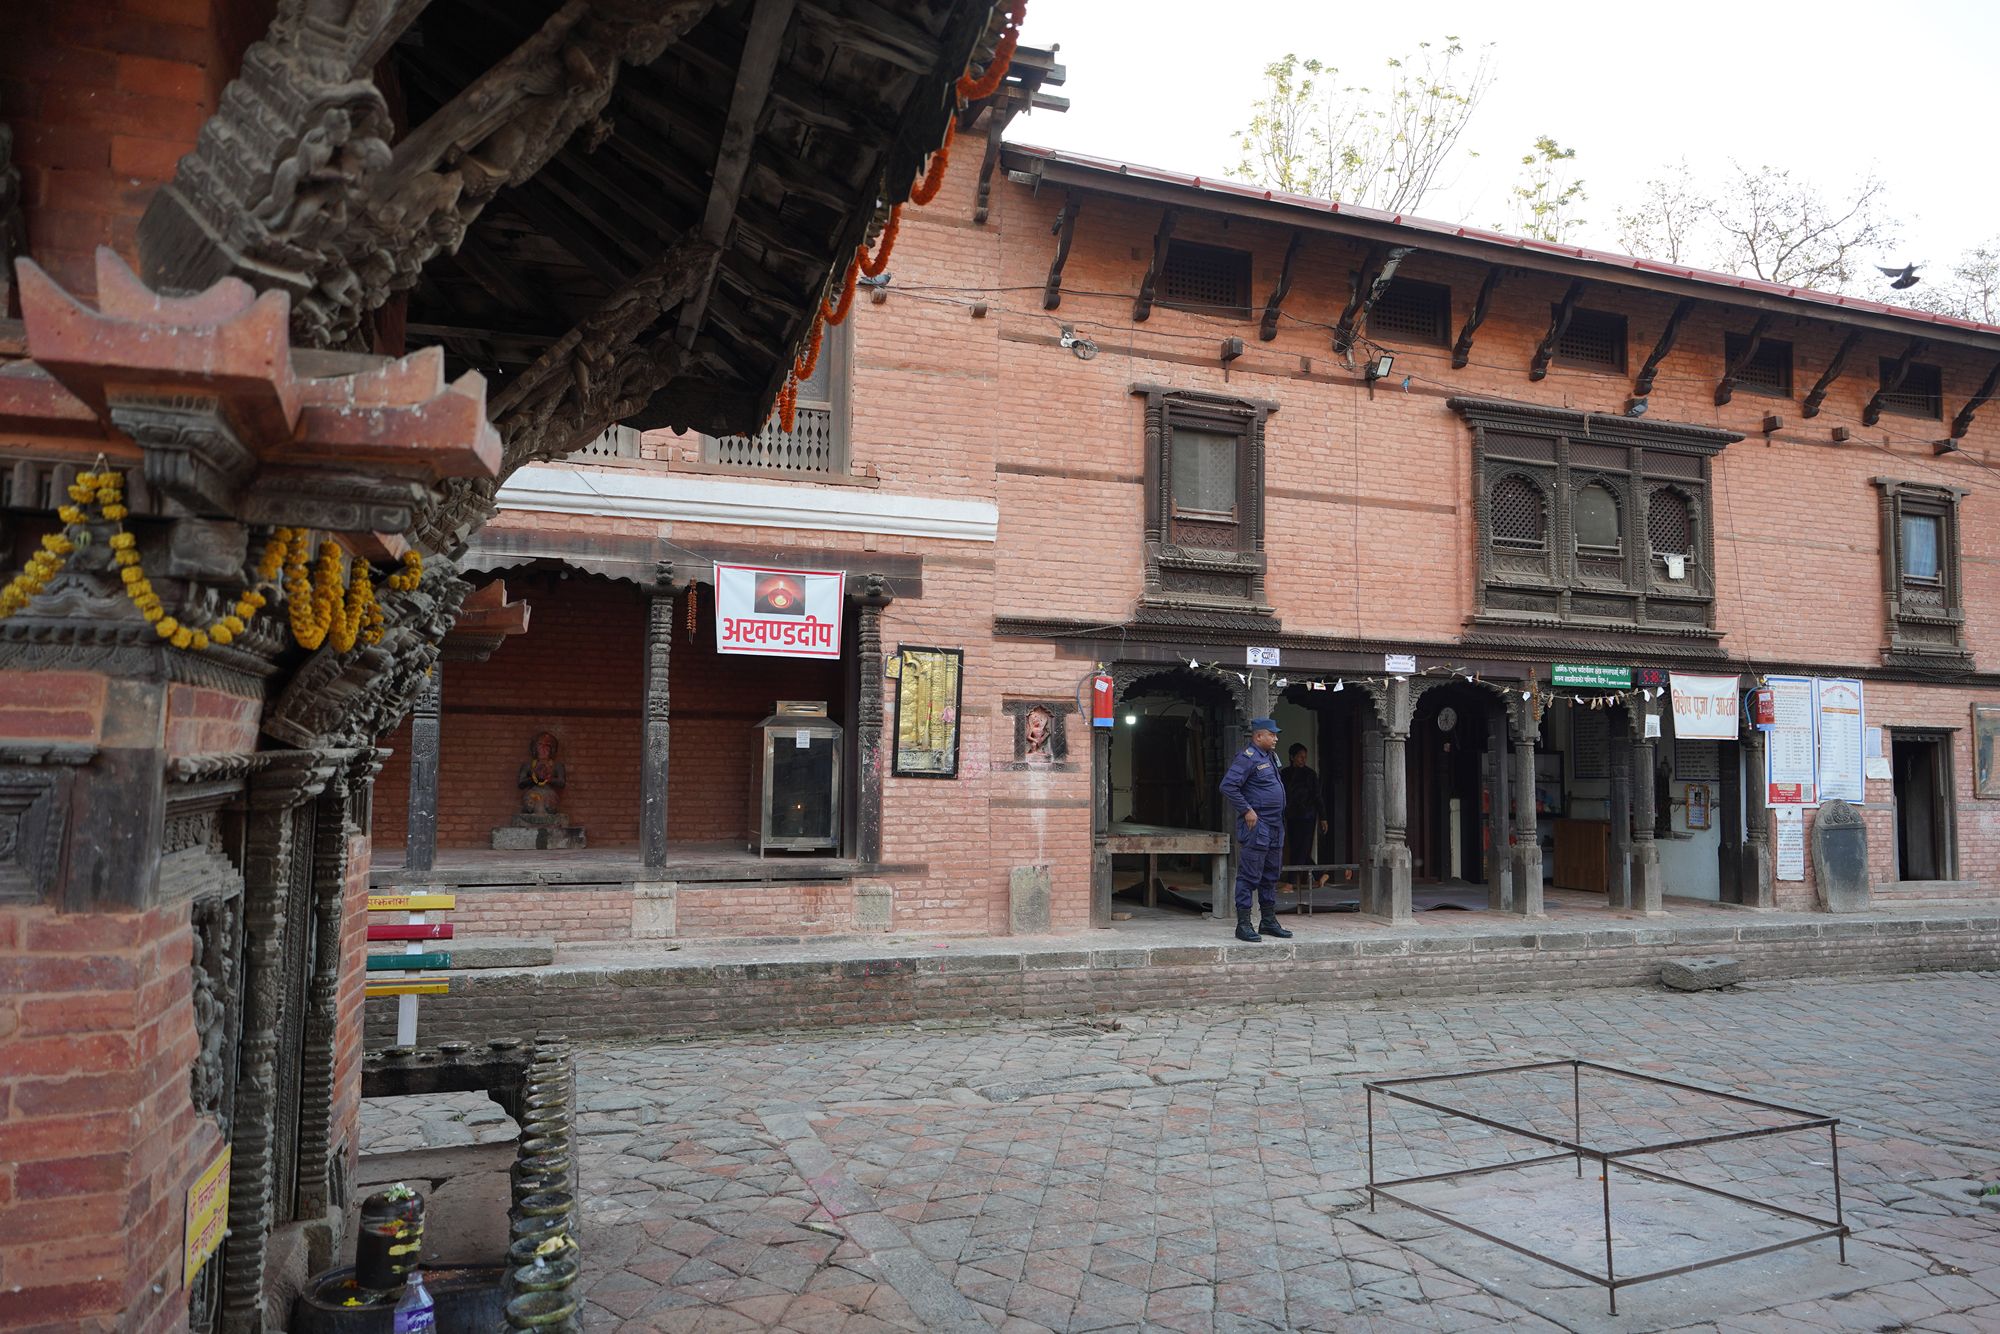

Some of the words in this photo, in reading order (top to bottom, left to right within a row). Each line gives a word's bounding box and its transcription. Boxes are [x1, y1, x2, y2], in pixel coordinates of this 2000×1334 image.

[722, 615, 834, 648] अखण्डदीप
[1672, 689, 1692, 716] विशेष
[1693, 696, 1708, 720] पूजा
[1715, 692, 1737, 716] आरती
